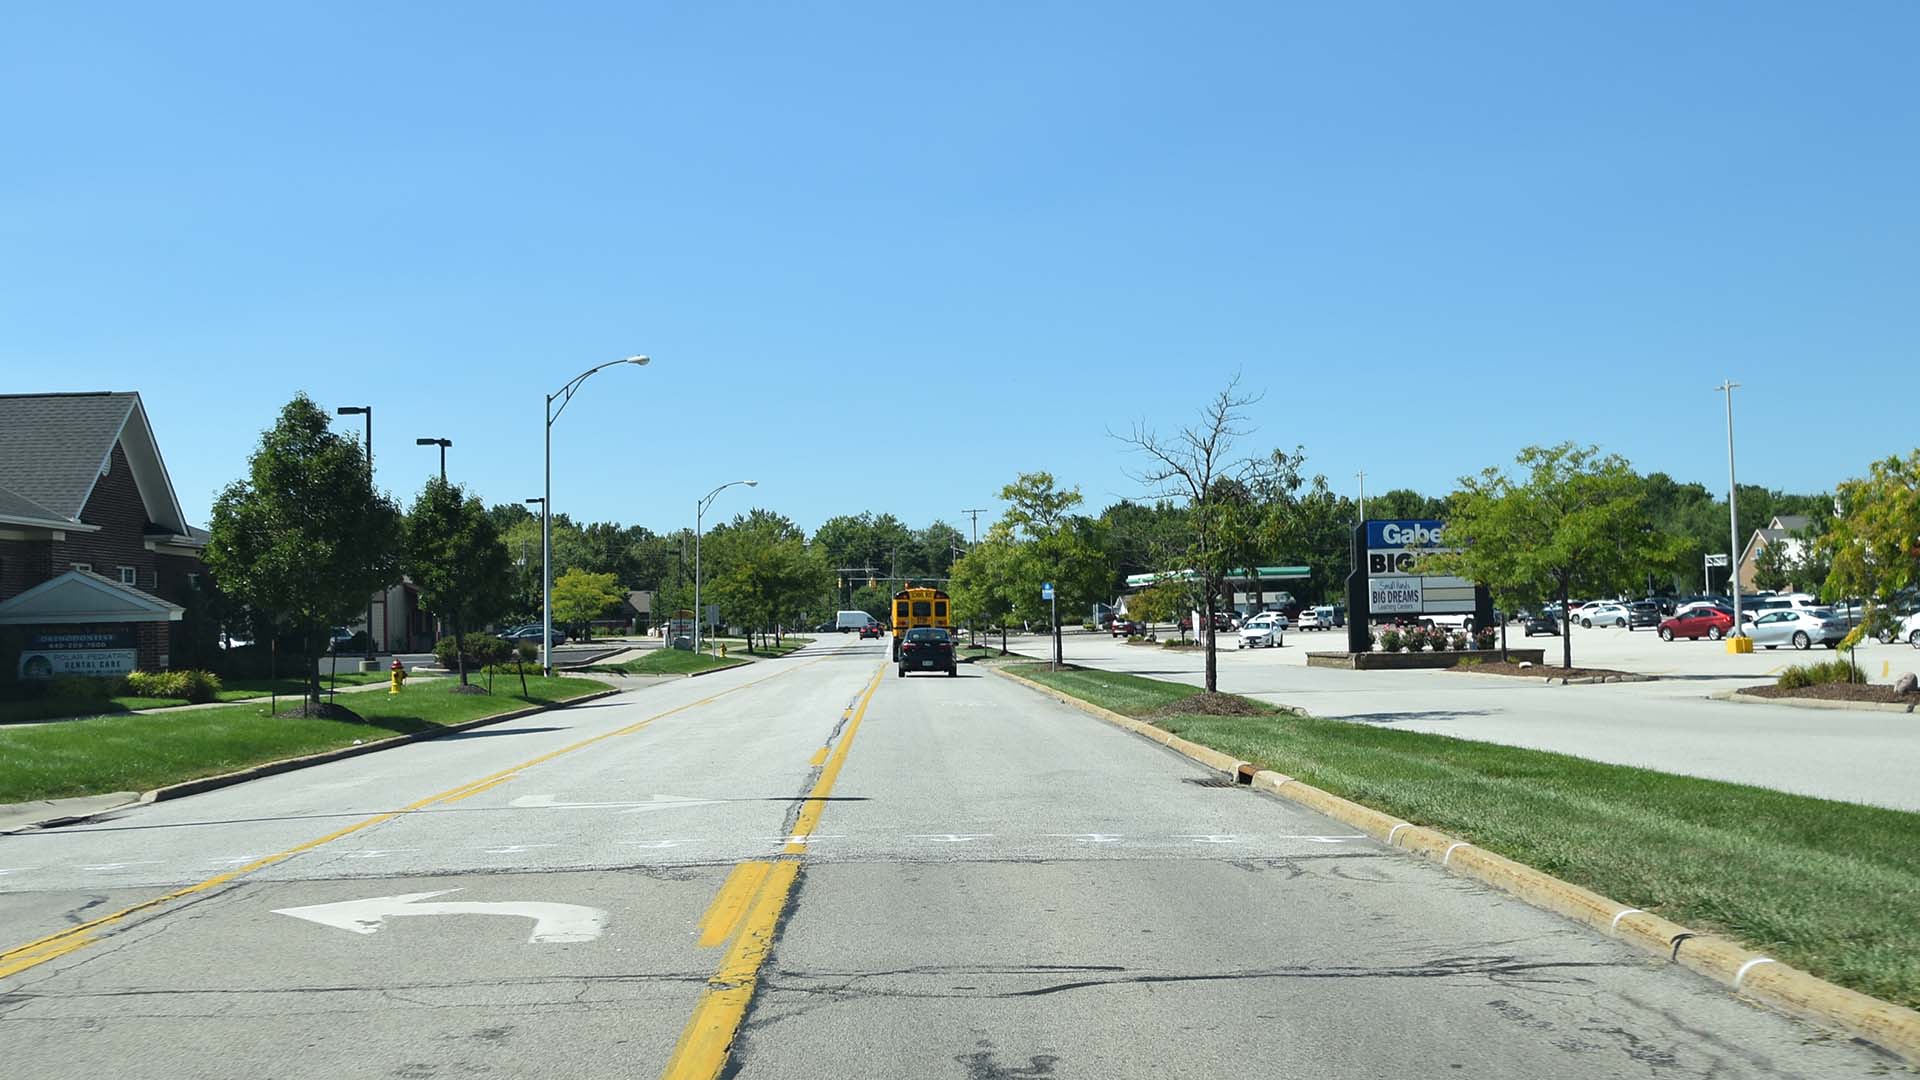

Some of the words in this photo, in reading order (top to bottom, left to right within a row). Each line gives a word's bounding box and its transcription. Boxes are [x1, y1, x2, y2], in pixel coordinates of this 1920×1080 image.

[1372, 591, 1386, 604] BIG
[1387, 590, 1419, 603] DREAMS
[64, 660, 97, 669] DENTAL
[99, 660, 121, 668] CARE
